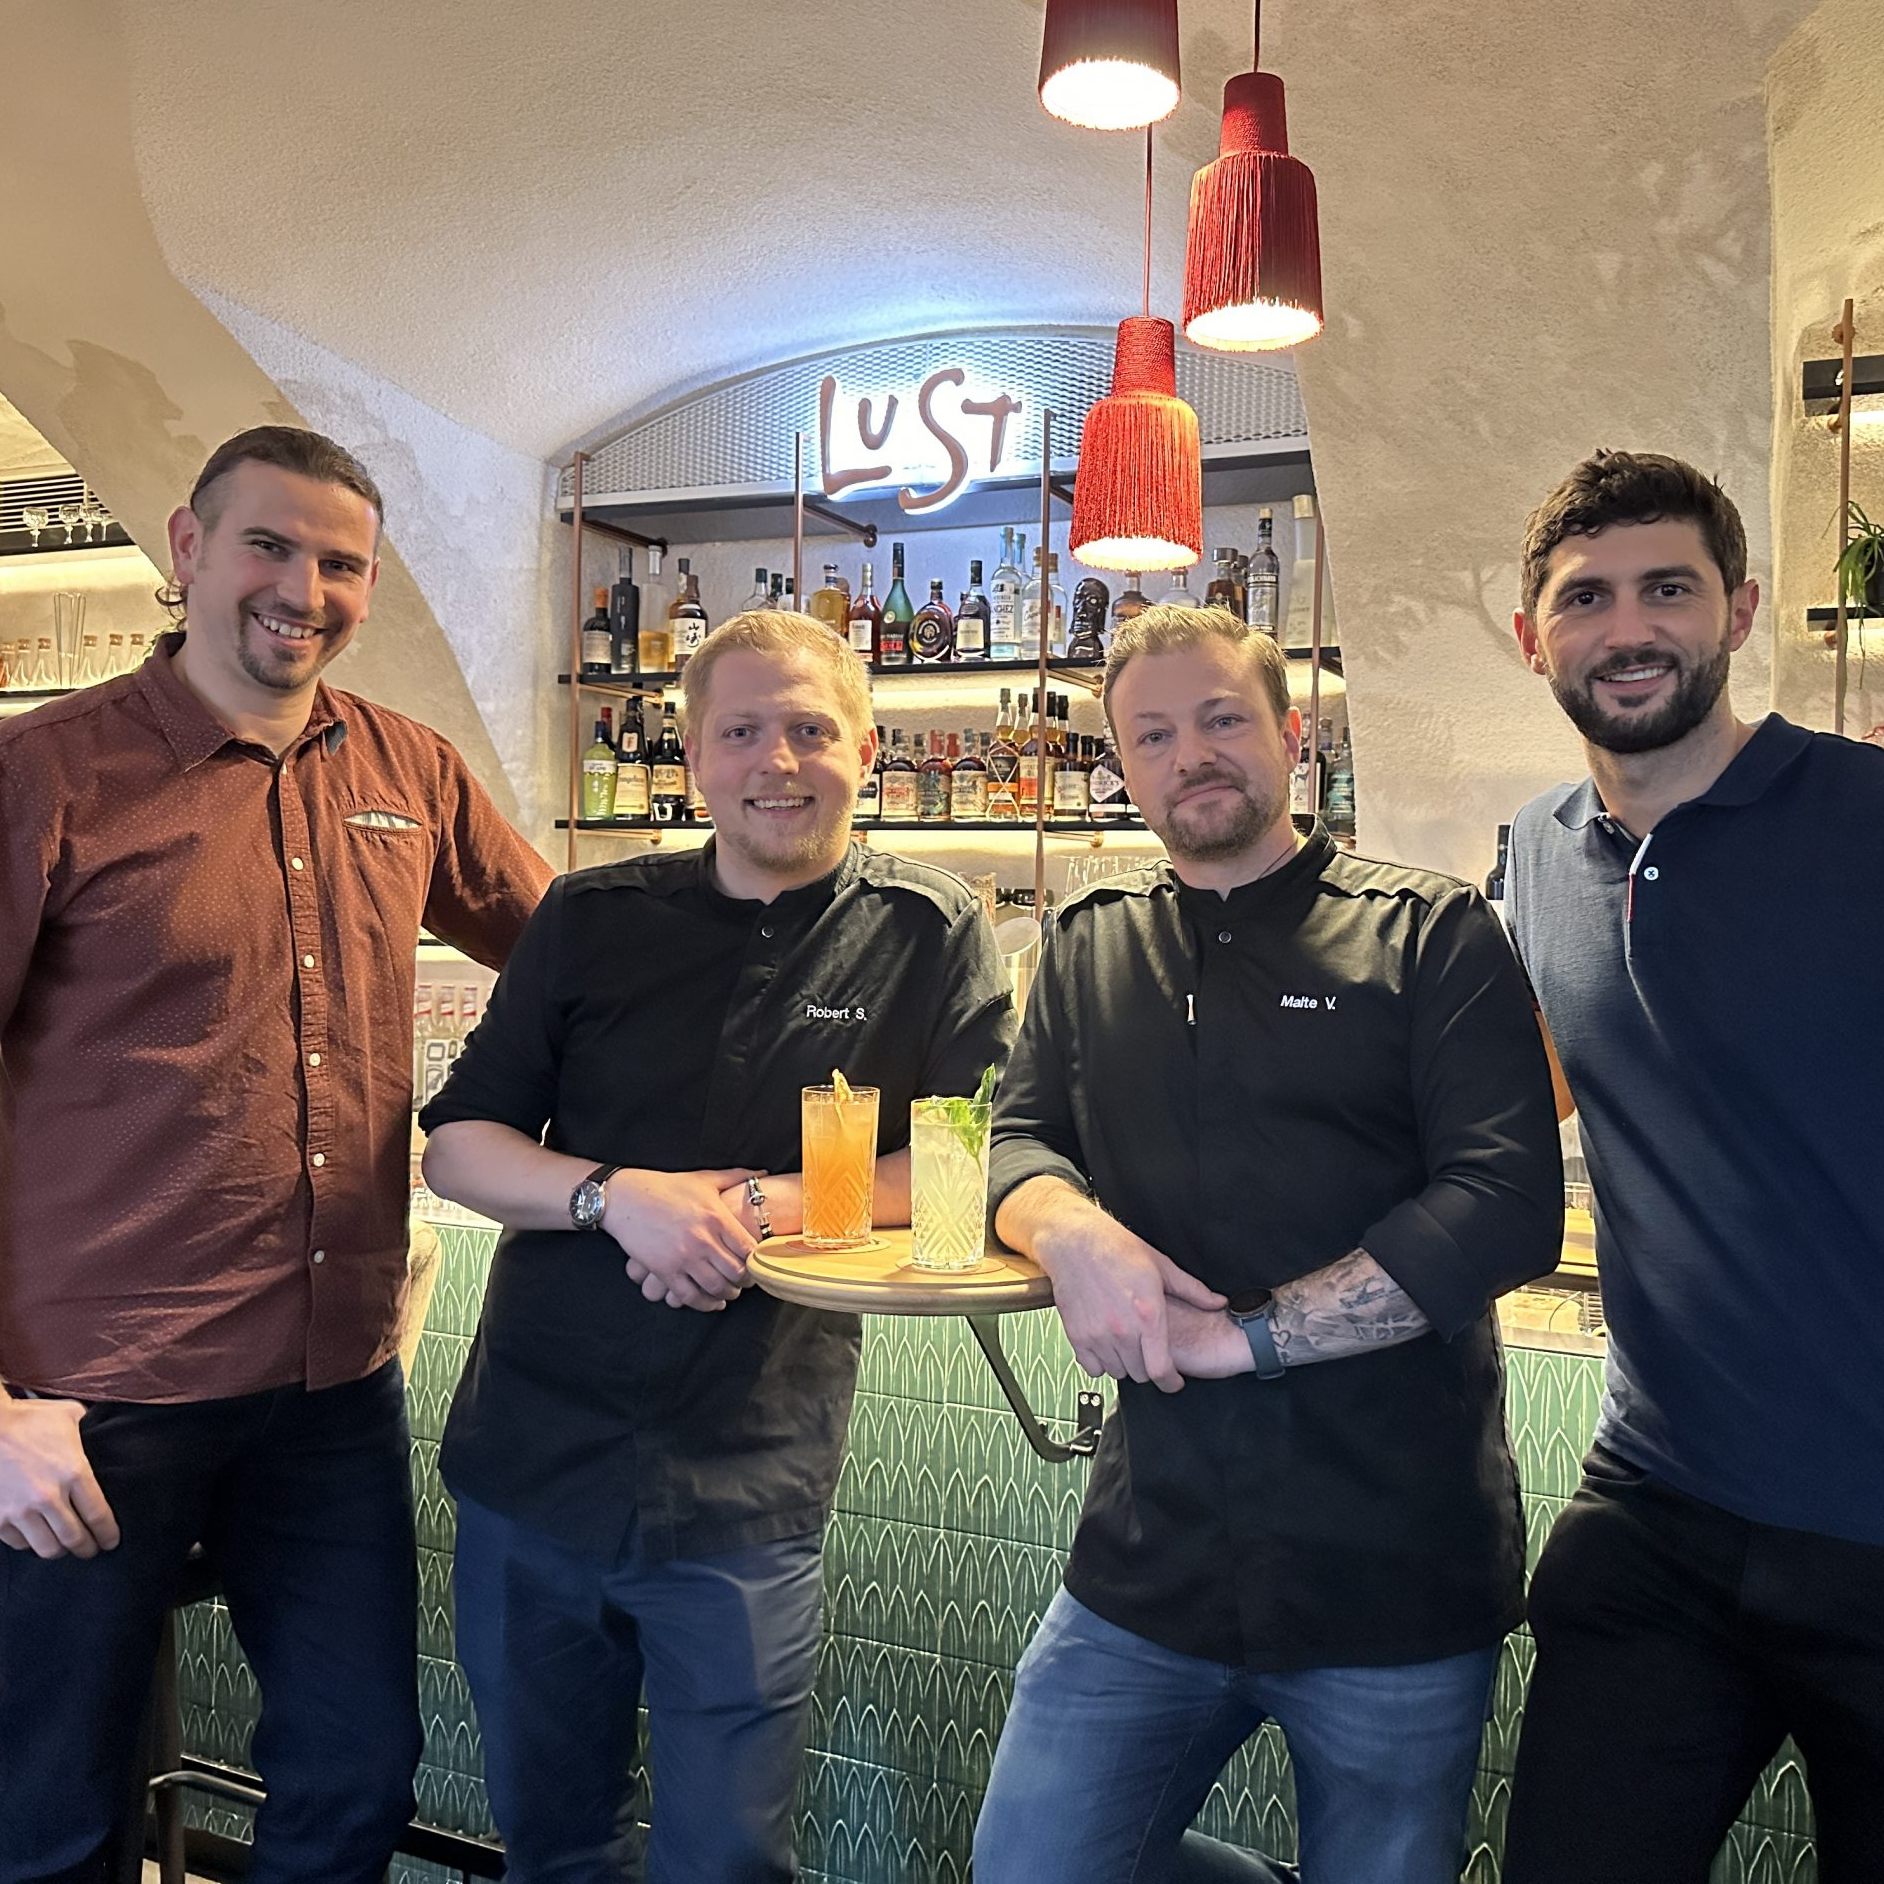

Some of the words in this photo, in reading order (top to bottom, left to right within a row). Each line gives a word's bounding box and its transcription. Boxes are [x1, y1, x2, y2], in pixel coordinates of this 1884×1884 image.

[1280, 994, 1318, 1009] Malte
[1325, 995, 1337, 1010] V.
[806, 1004, 850, 1019] Robert
[855, 1007, 868, 1021] S.
